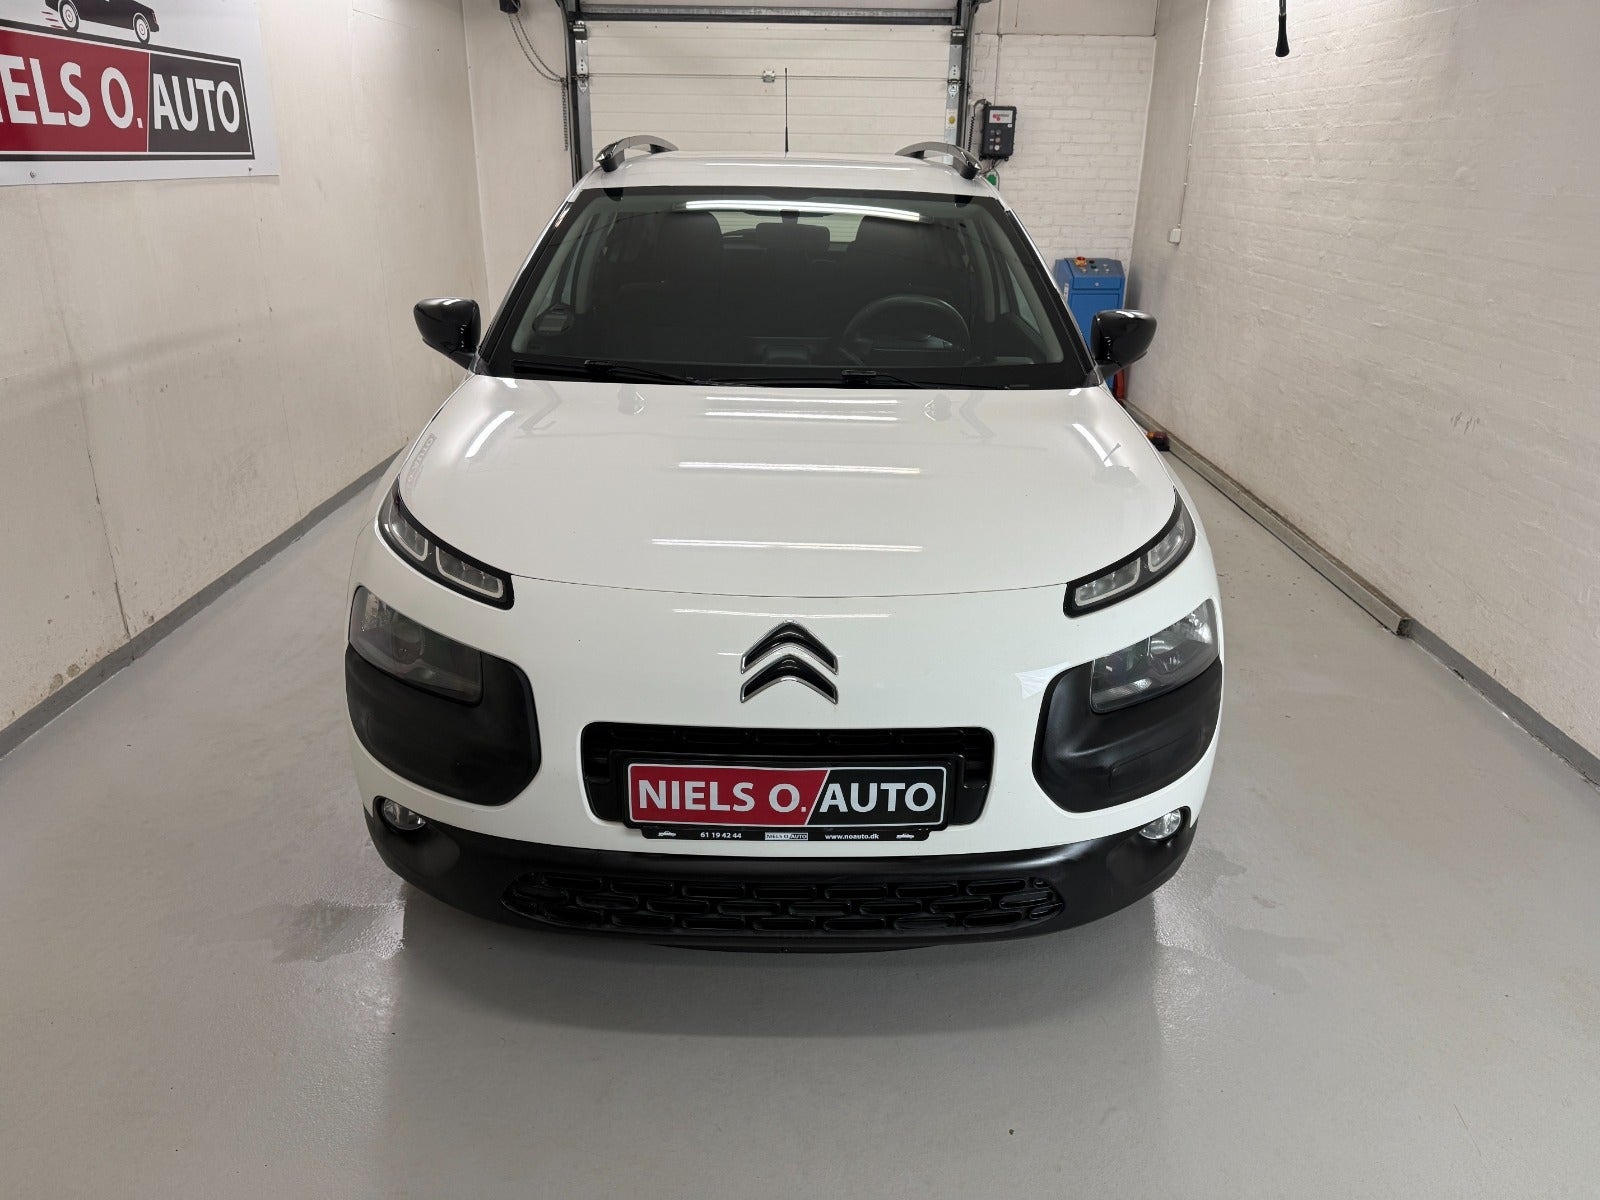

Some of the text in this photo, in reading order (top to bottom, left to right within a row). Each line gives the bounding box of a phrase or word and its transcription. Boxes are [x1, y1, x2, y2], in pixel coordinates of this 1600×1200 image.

[0, 54, 240, 133] ELS O. AUTO
[638, 779, 937, 813] NIELS O. AUTO
